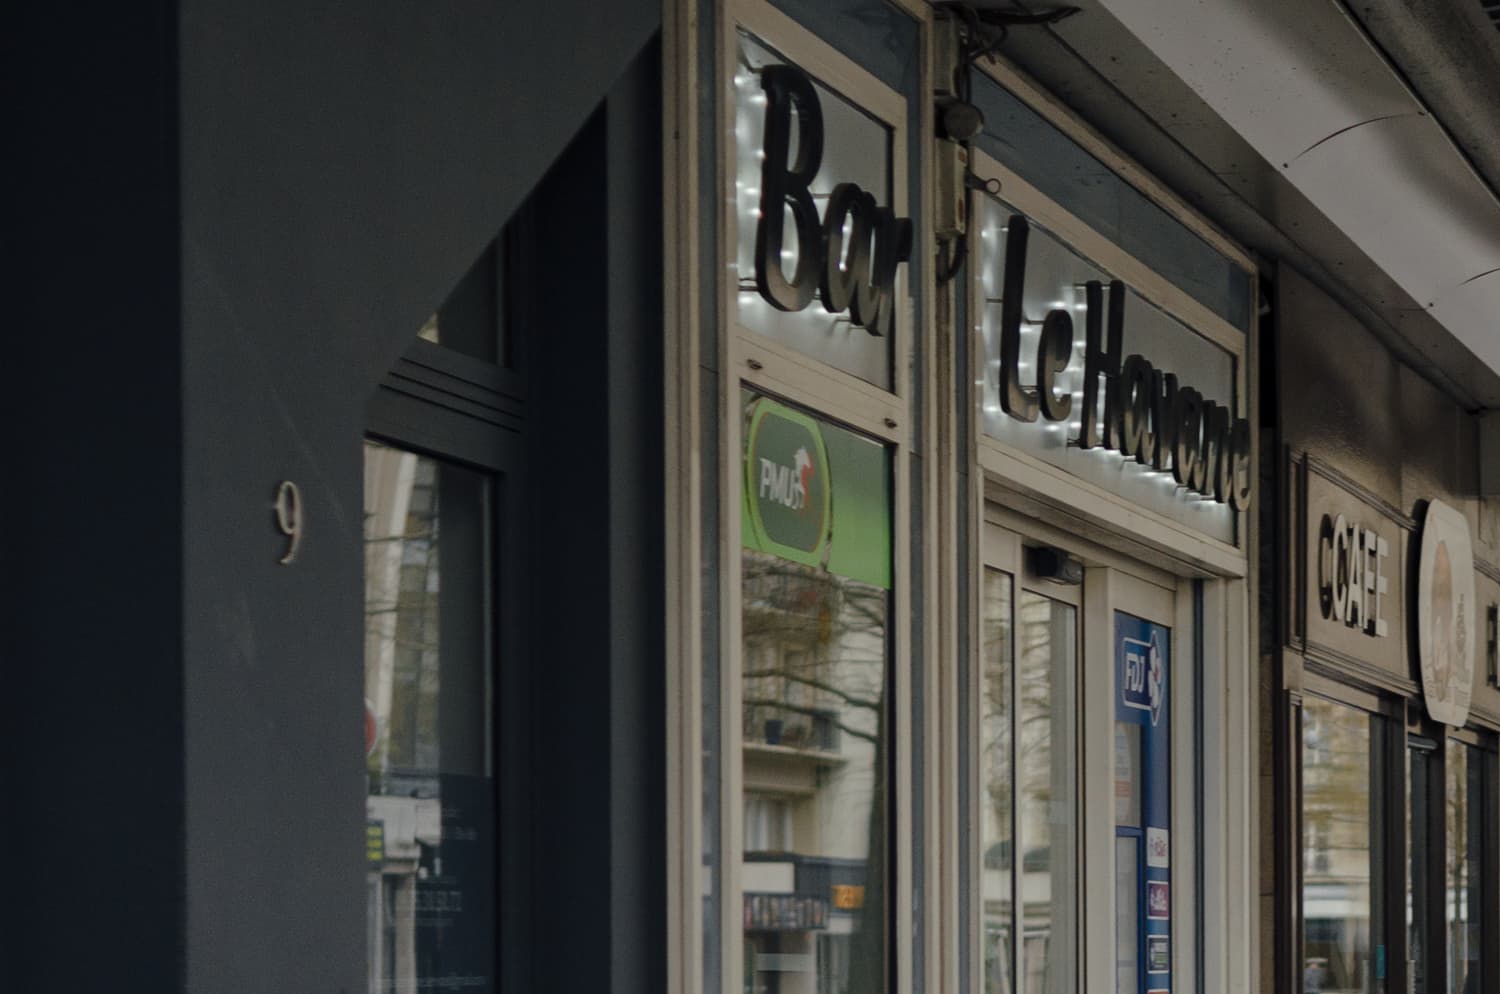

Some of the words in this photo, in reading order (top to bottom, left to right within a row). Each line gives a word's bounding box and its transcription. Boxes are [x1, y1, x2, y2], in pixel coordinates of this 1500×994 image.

[756, 64, 913, 337] Bar
[1000, 214, 1074, 423] Le
[1080, 279, 1251, 512] Havane
[273, 480, 302, 566] 9
[760, 457, 799, 510] PMU
[1330, 512, 1389, 637] CAFE
[1125, 651, 1146, 693] FDJ
